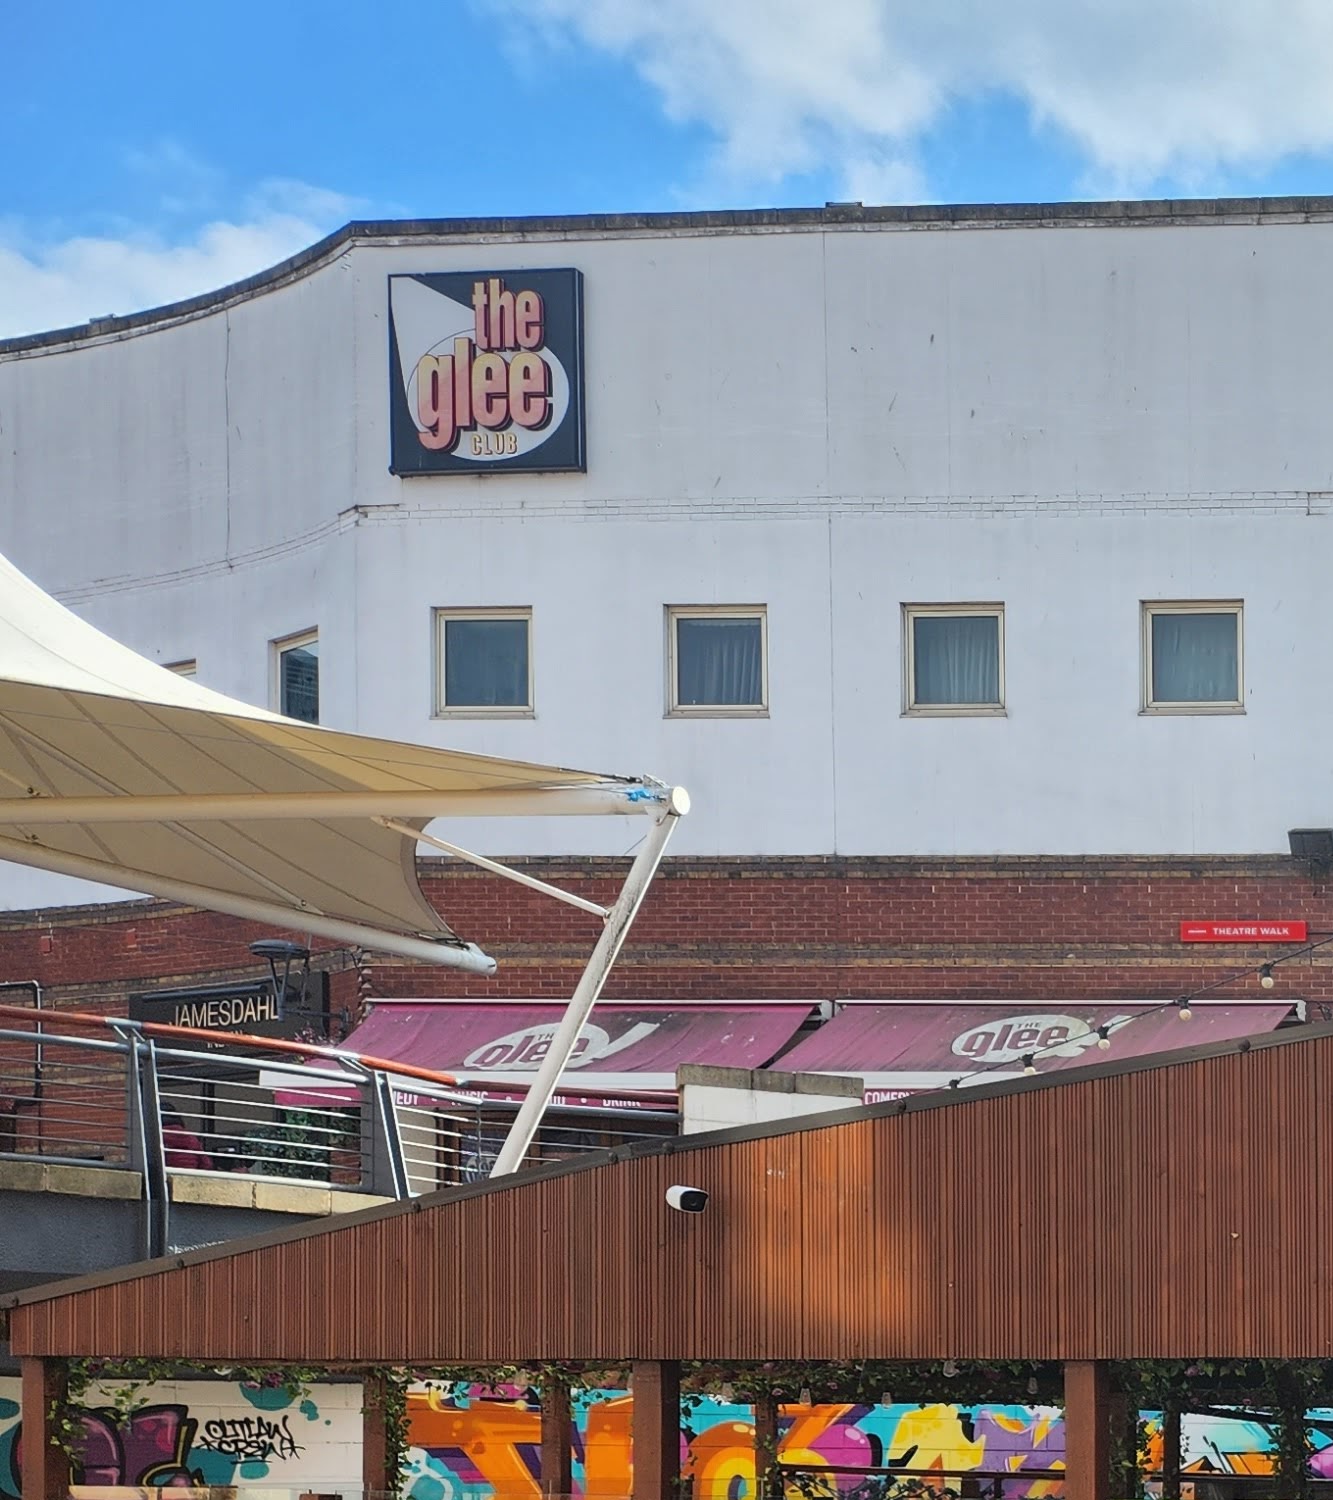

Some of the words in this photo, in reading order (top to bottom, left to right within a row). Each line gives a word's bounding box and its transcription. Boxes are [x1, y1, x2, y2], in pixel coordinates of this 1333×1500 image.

[472, 278, 544, 352] the
[417, 337, 553, 453] glee
[472, 433, 517, 455] CLUB
[1213, 927, 1257, 935] THEATRE
[1260, 927, 1289, 935] WALK
